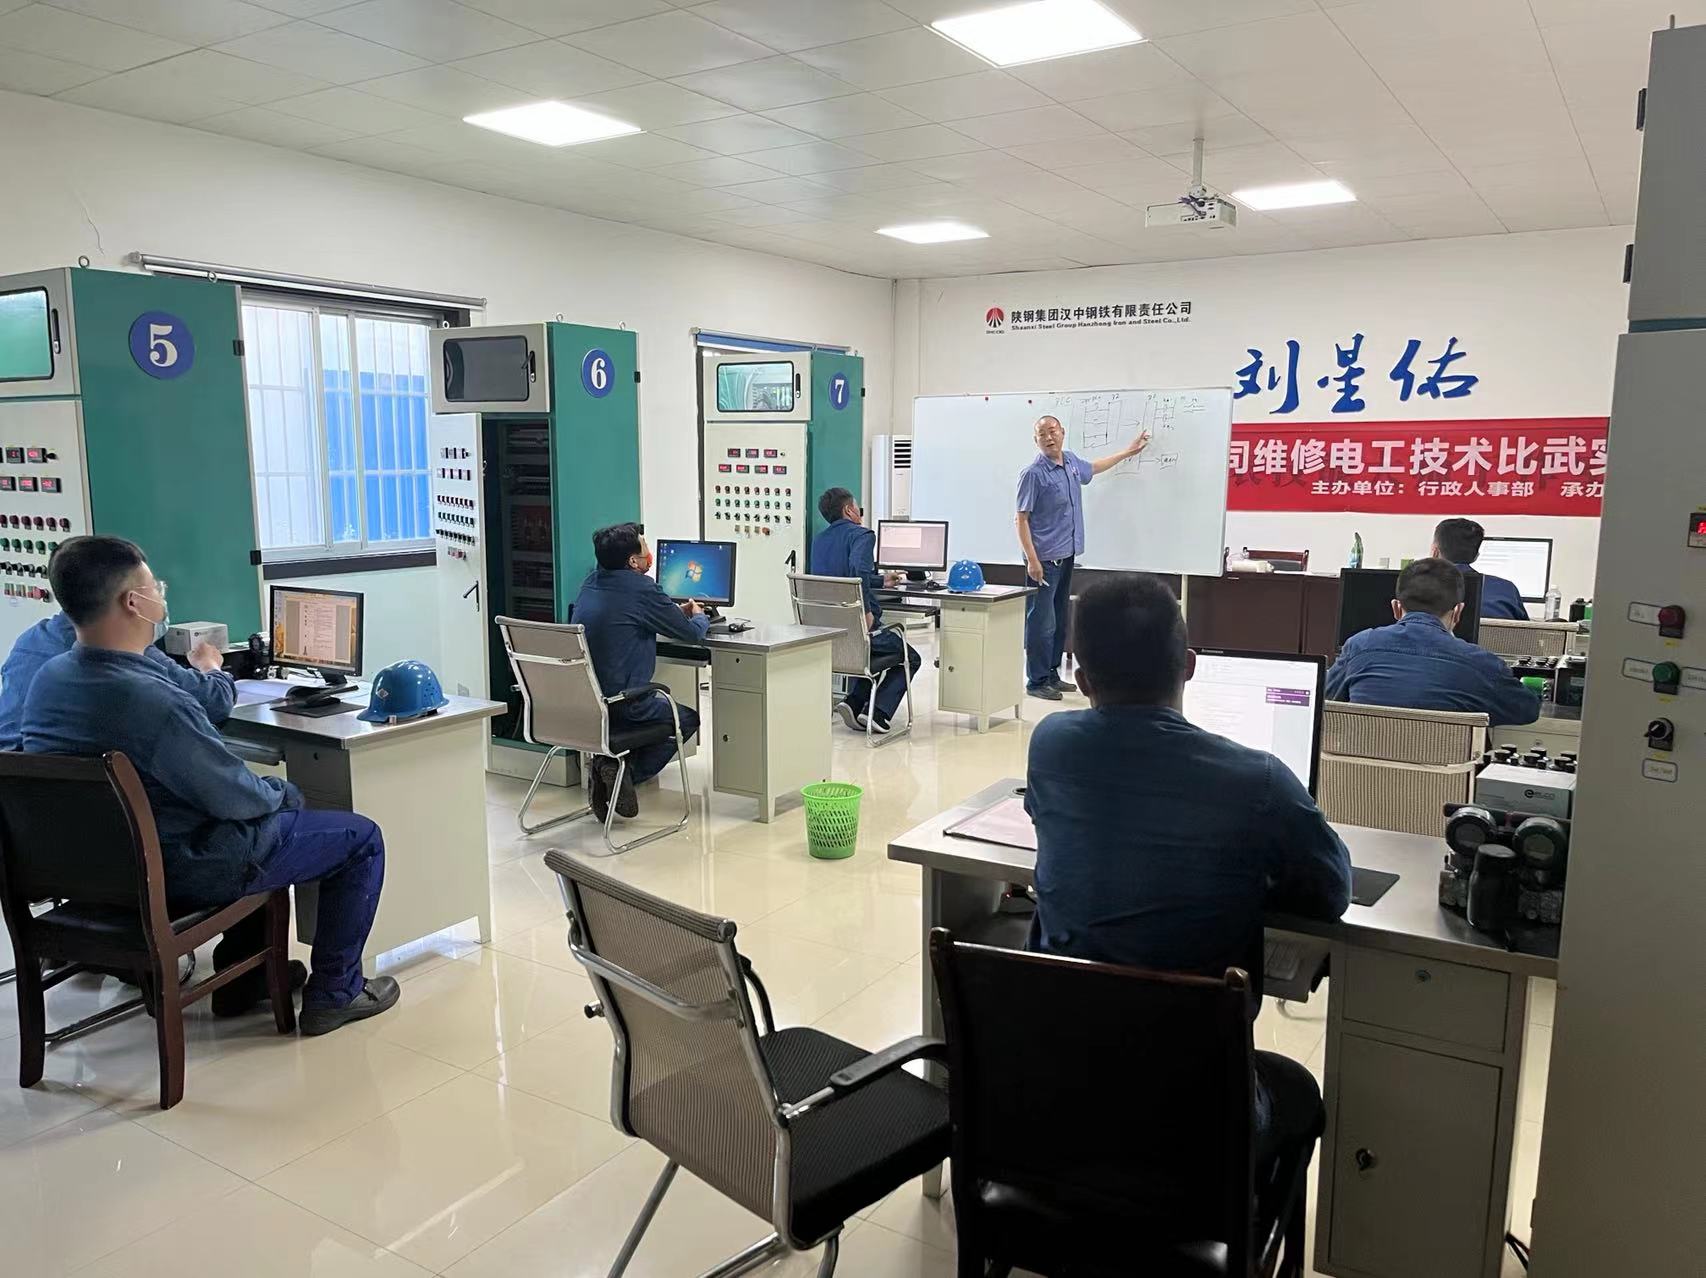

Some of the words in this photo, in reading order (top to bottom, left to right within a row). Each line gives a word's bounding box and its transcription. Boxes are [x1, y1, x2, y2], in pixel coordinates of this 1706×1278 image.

[1011, 301, 1192, 323] 陕钢集团汉中钢铁有限责任公司
[149, 323, 179, 368] 5
[590, 357, 608, 390] 6
[1233, 333, 1479, 414] 刘星佑
[834, 378, 846, 404] 7
